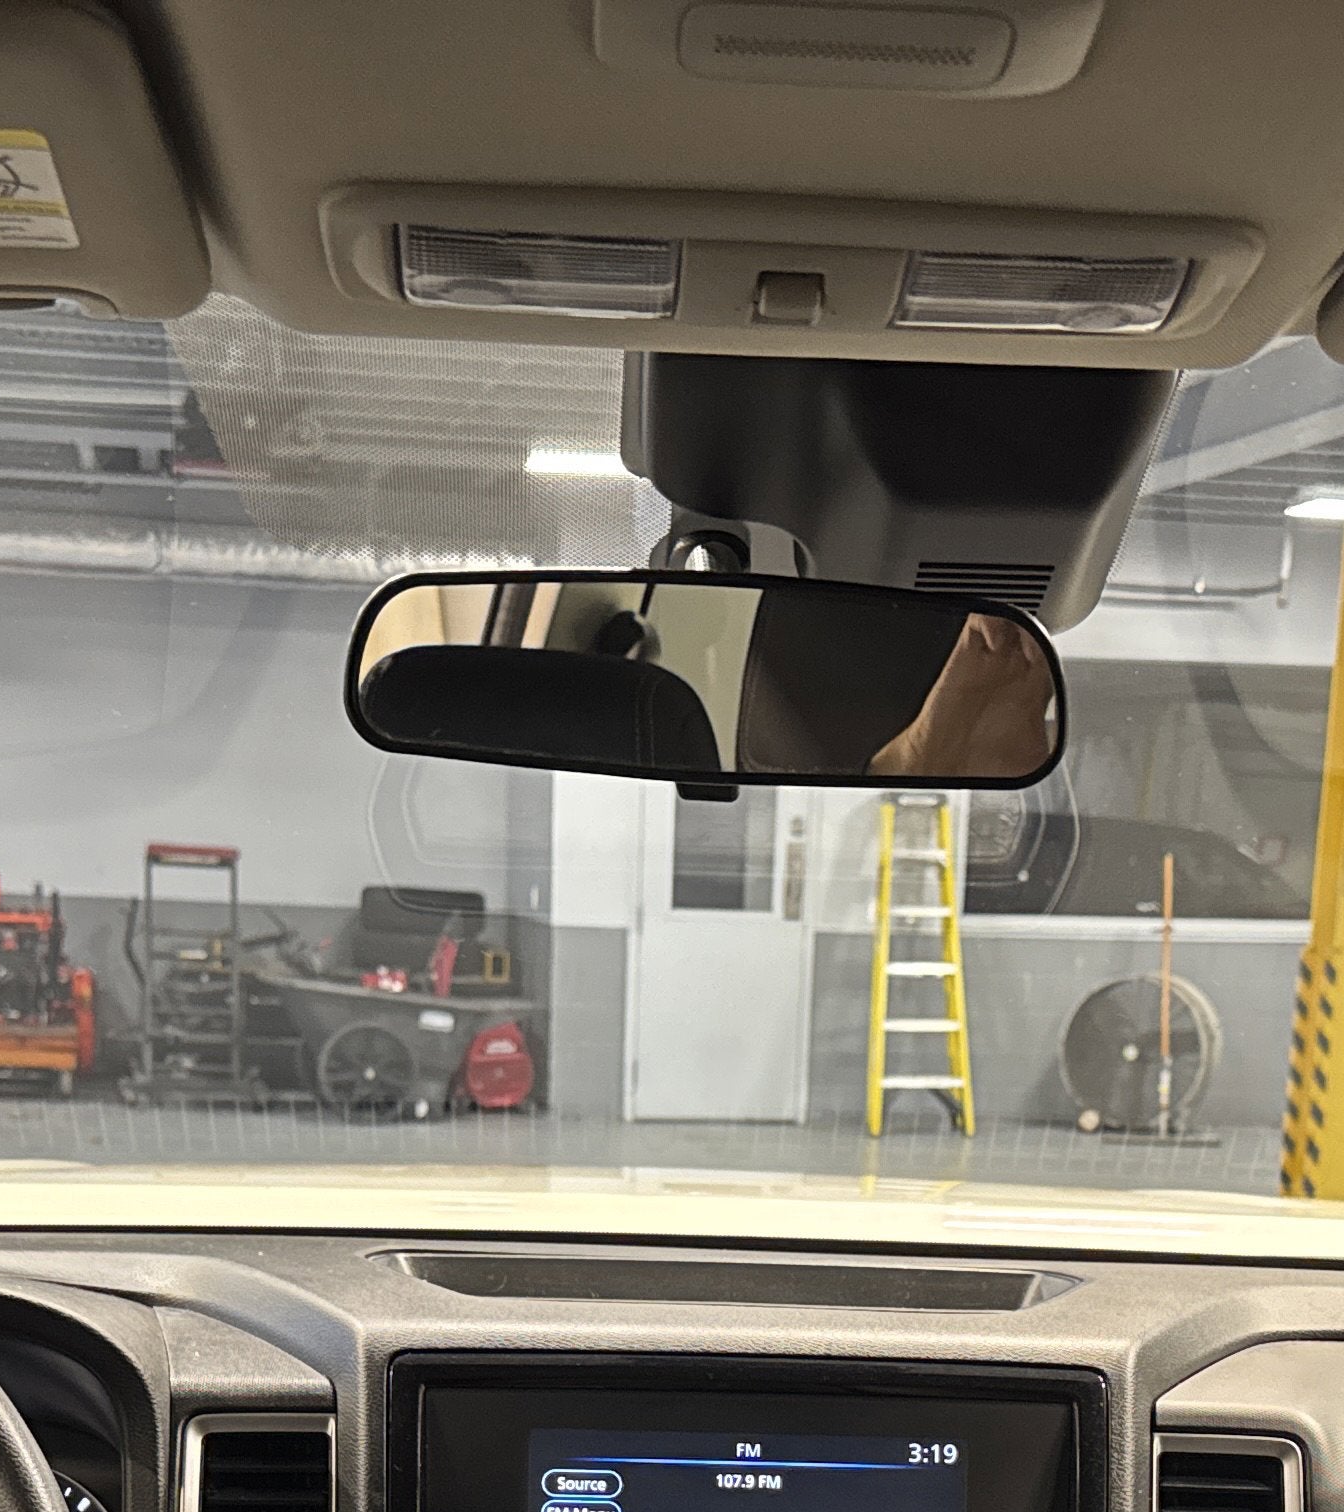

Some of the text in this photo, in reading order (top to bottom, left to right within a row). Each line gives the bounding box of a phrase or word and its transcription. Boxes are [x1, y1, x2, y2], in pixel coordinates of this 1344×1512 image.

[736, 1443, 761, 1458] FM
[908, 1443, 958, 1465] 3:19
[557, 1475, 608, 1492] Source
[716, 1474, 782, 1490] 107.9 FM
